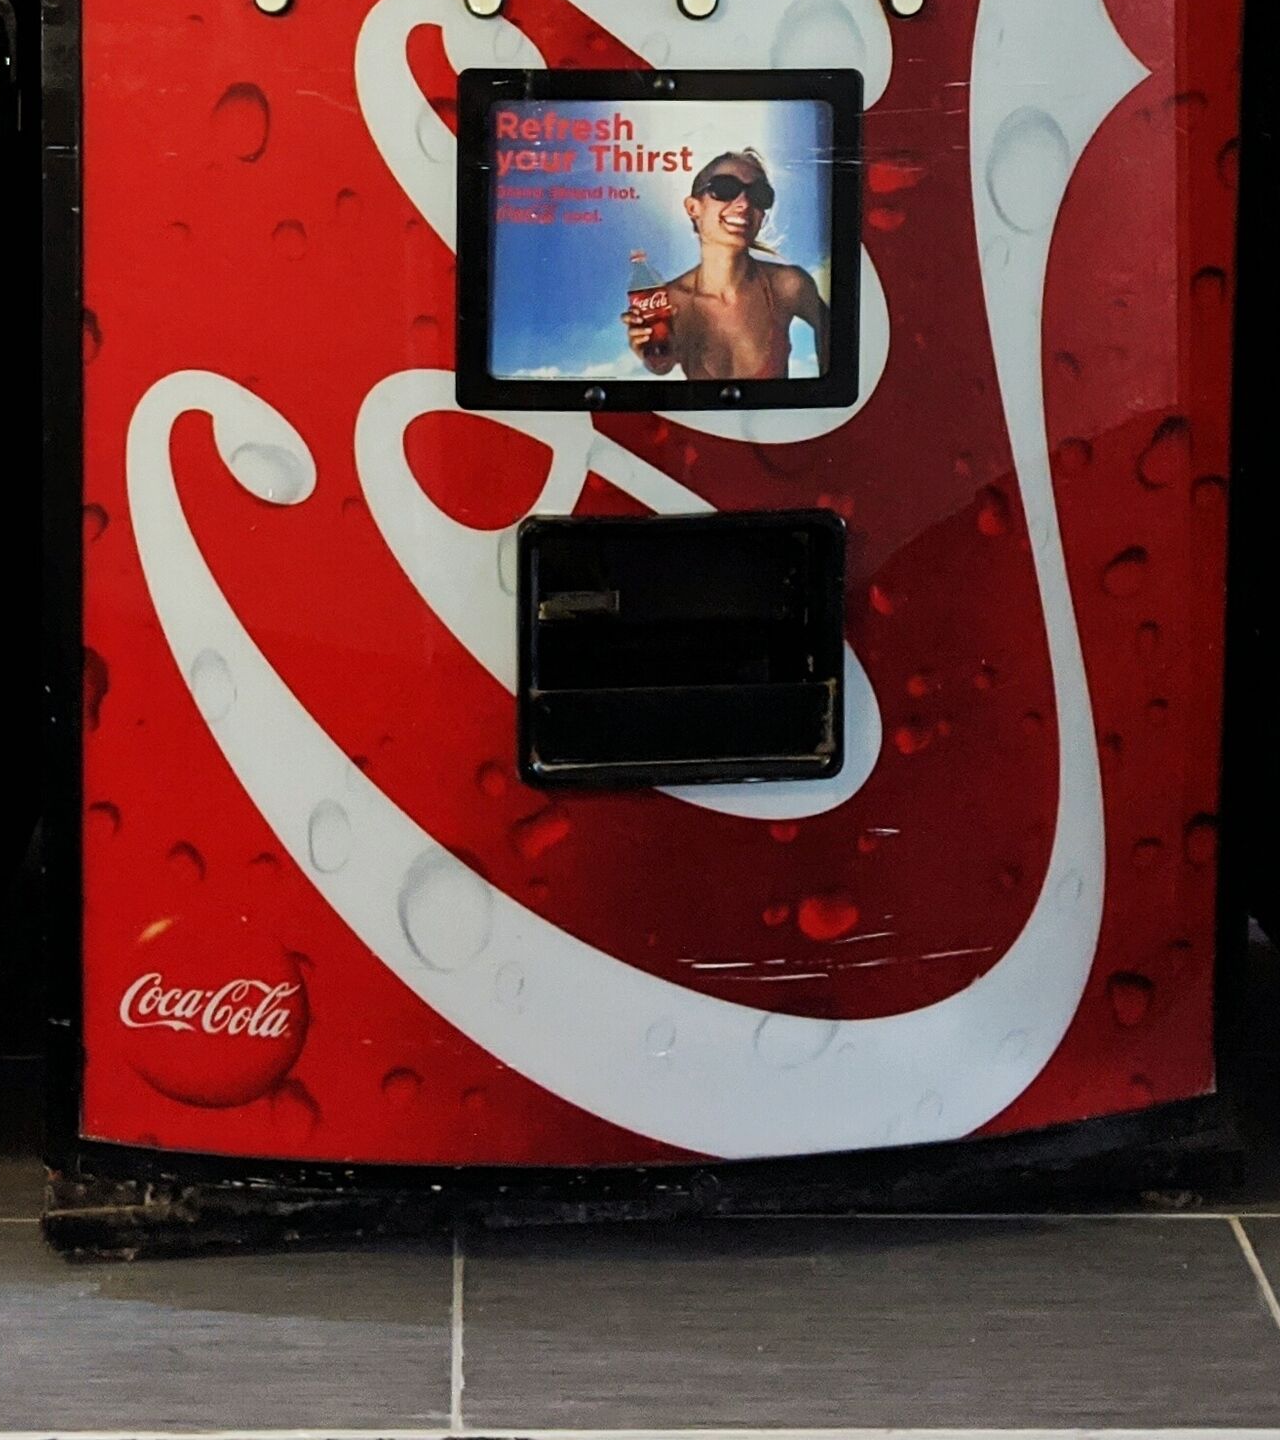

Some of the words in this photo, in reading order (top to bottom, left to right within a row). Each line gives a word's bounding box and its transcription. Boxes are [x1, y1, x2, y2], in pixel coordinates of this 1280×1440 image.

[496, 111, 633, 142] Refresh
[496, 148, 578, 177] your
[588, 143, 694, 172] Thirst
[608, 186, 641, 200] hot.
[120, 972, 301, 1039] Coca-Cola
